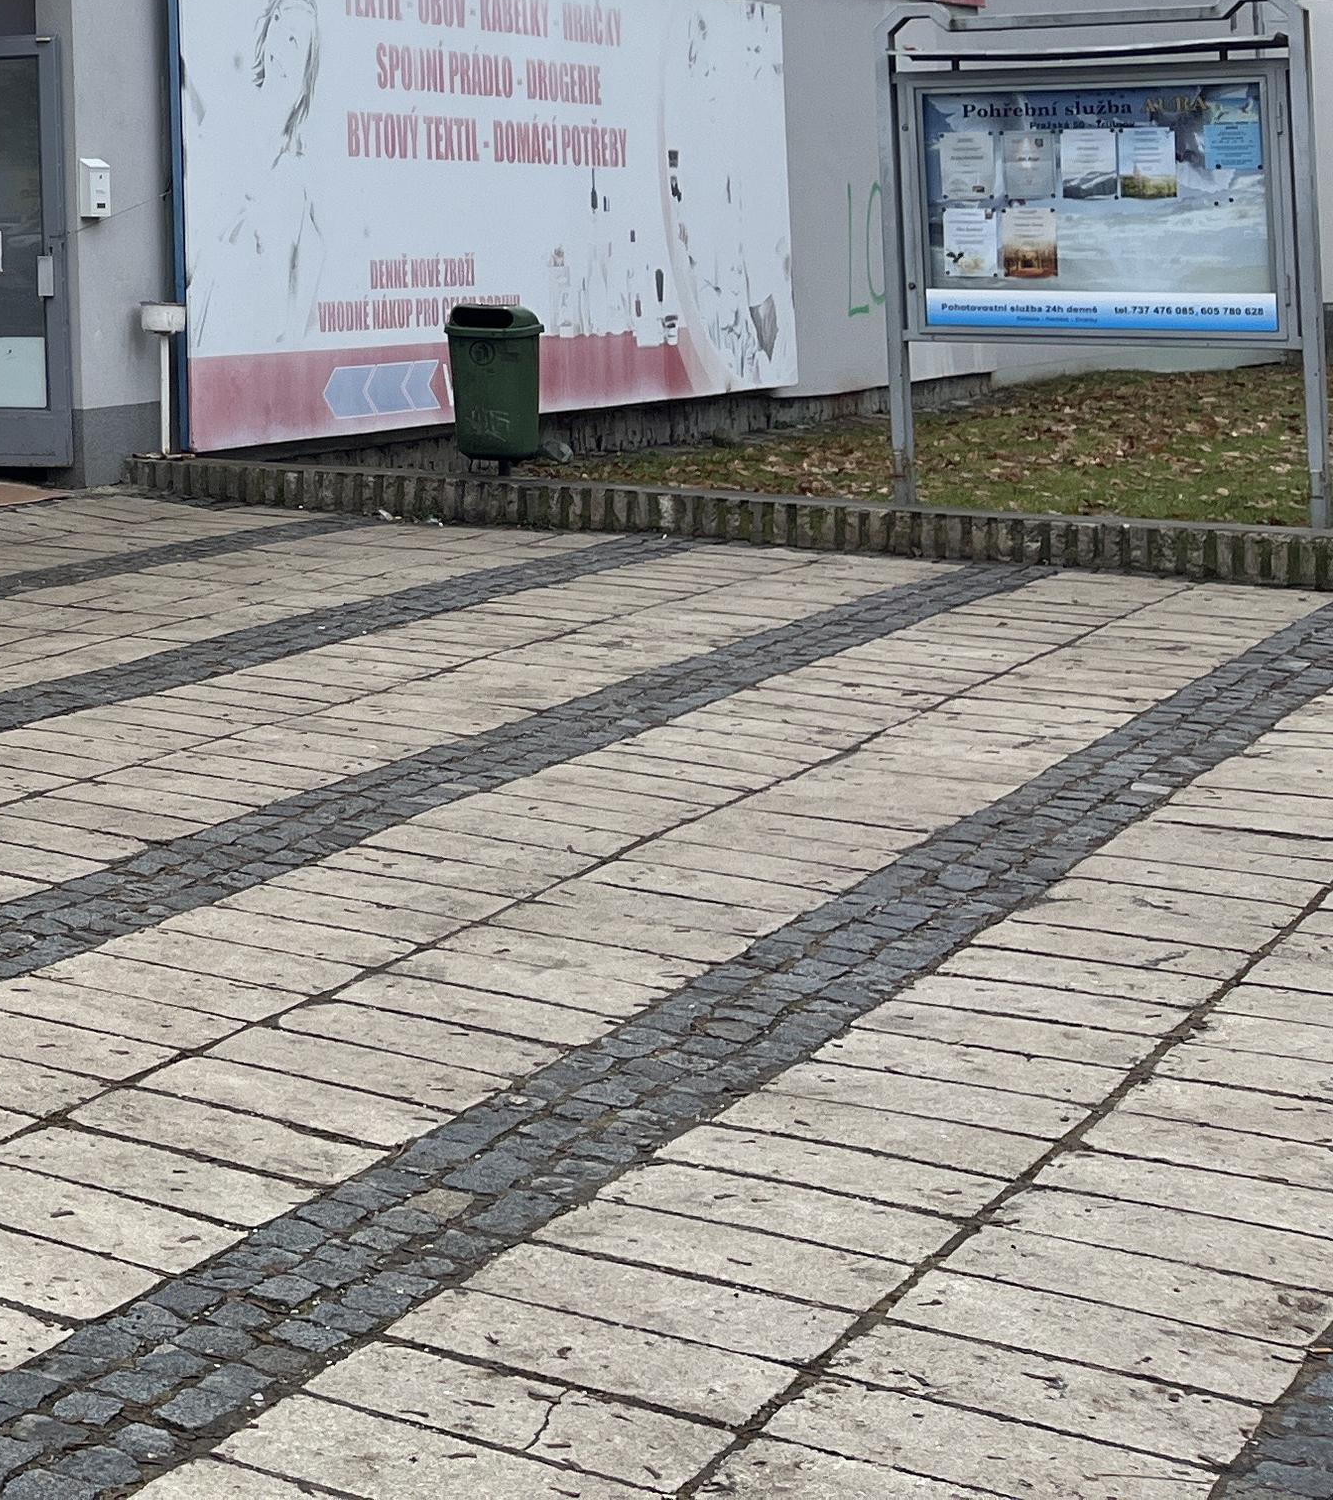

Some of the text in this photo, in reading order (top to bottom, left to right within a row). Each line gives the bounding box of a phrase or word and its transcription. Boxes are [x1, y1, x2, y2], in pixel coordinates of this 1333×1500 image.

[376, 40, 445, 93] SPODNÍ
[449, 45, 513, 98] PRÁDLO
[526, 58, 602, 105] DROGERIE
[962, 100, 1057, 118] Pohřební
[1065, 99, 1132, 116] služba
[347, 106, 419, 160] BYTOVÝ
[423, 116, 480, 162] TEXTIL
[493, 114, 558, 165] DOMÁCÍ
[561, 118, 627, 168] POTŘEBY
[370, 252, 475, 290] DENNĚ NOVÉ ZBOŽÍ
[372, 294, 413, 330] NÁKUP
[415, 298, 439, 327] PRO
[941, 303, 1007, 312] Pohotovostní
[1010, 304, 1042, 313] služba
[1045, 305, 1064, 313] 24h
[1066, 305, 1098, 314] denně
[1201, 307, 1220, 315] 605
